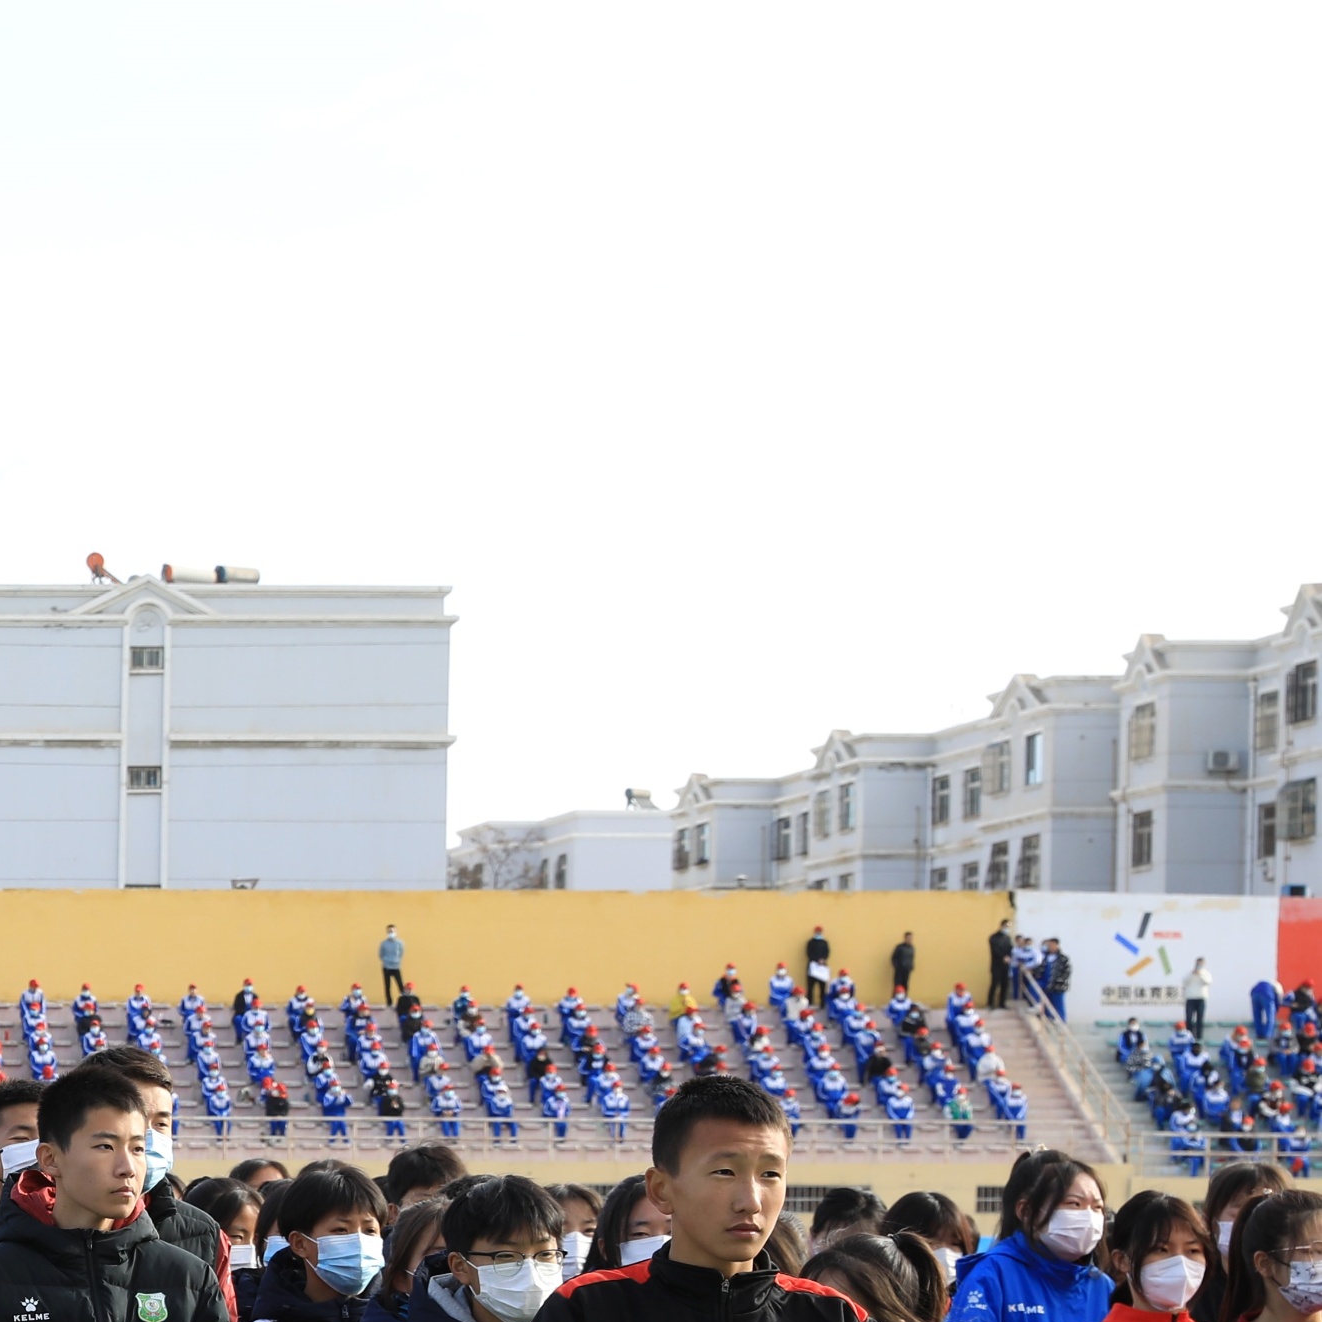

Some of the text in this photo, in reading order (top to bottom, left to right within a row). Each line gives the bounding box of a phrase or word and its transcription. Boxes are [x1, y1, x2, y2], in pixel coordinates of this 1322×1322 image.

[1101, 985, 1186, 999] 中国体育彩
[13, 1312, 50, 1322] KELME
